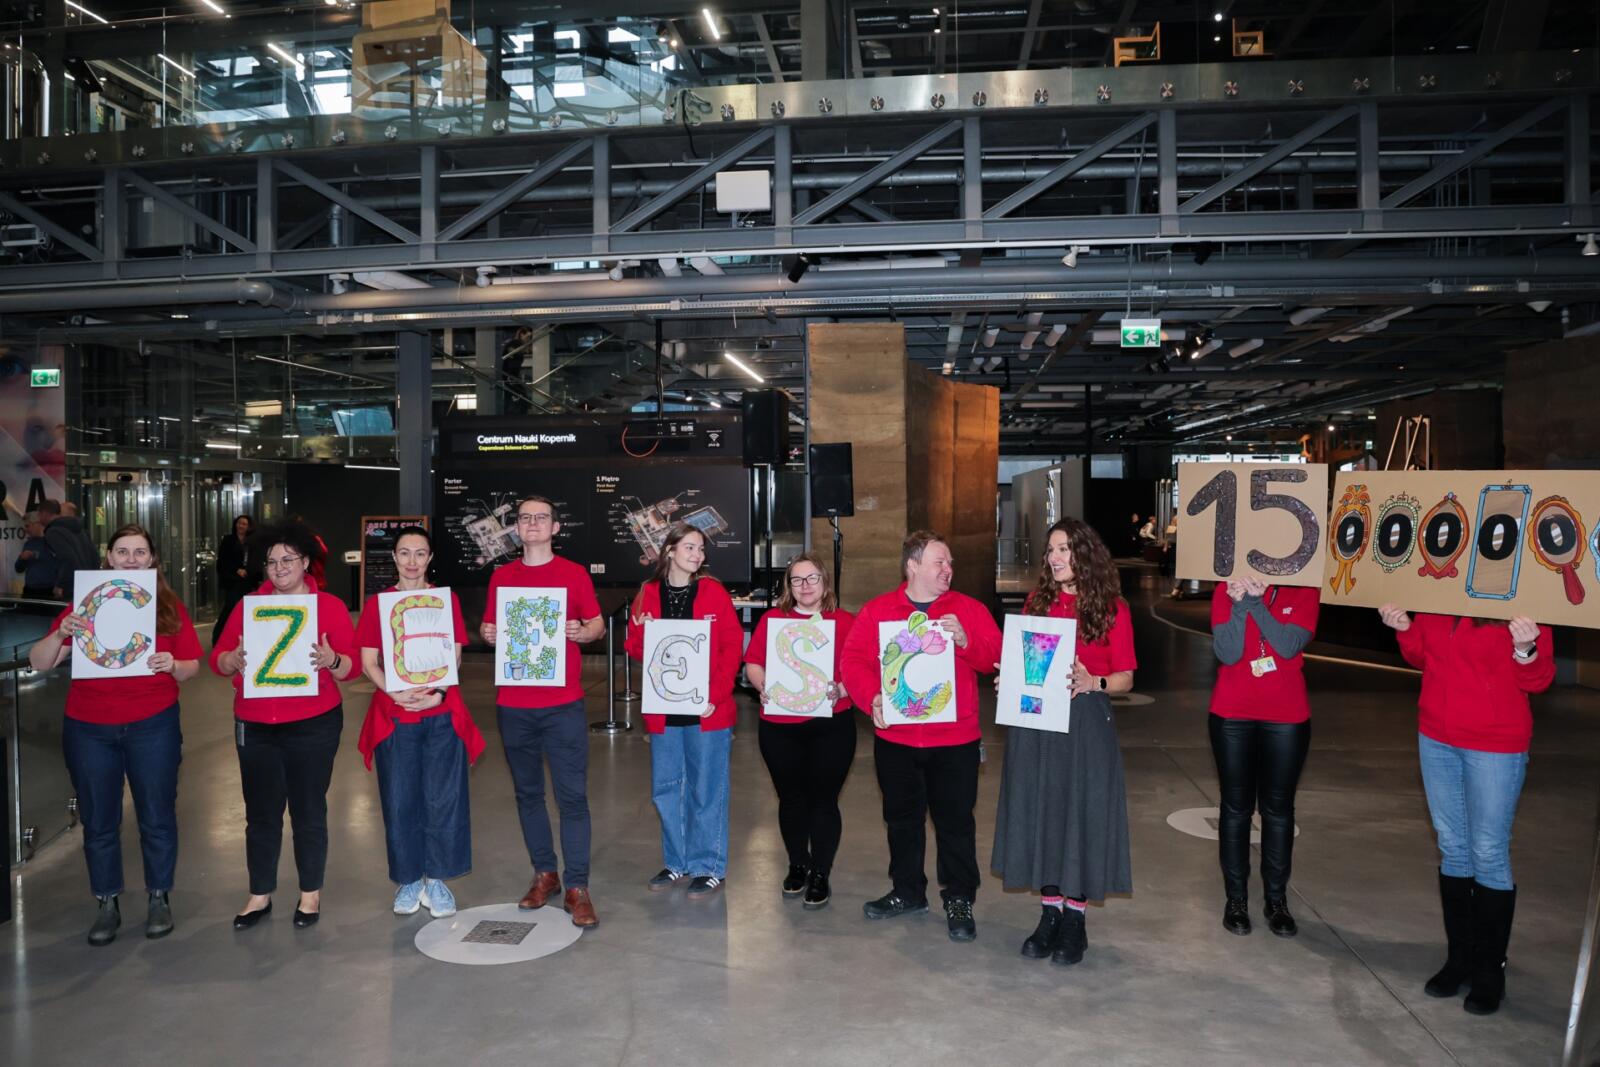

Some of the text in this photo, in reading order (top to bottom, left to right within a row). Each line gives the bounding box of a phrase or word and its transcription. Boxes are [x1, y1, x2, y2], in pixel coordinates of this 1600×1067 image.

[477, 433, 577, 444] Centrum Nauki Kopernik
[1187, 469, 1320, 577] 15
[73, 579, 152, 669] C
[253, 605, 309, 690] Z
[391, 594, 449, 684] E
[1020, 630, 1062, 715] !
